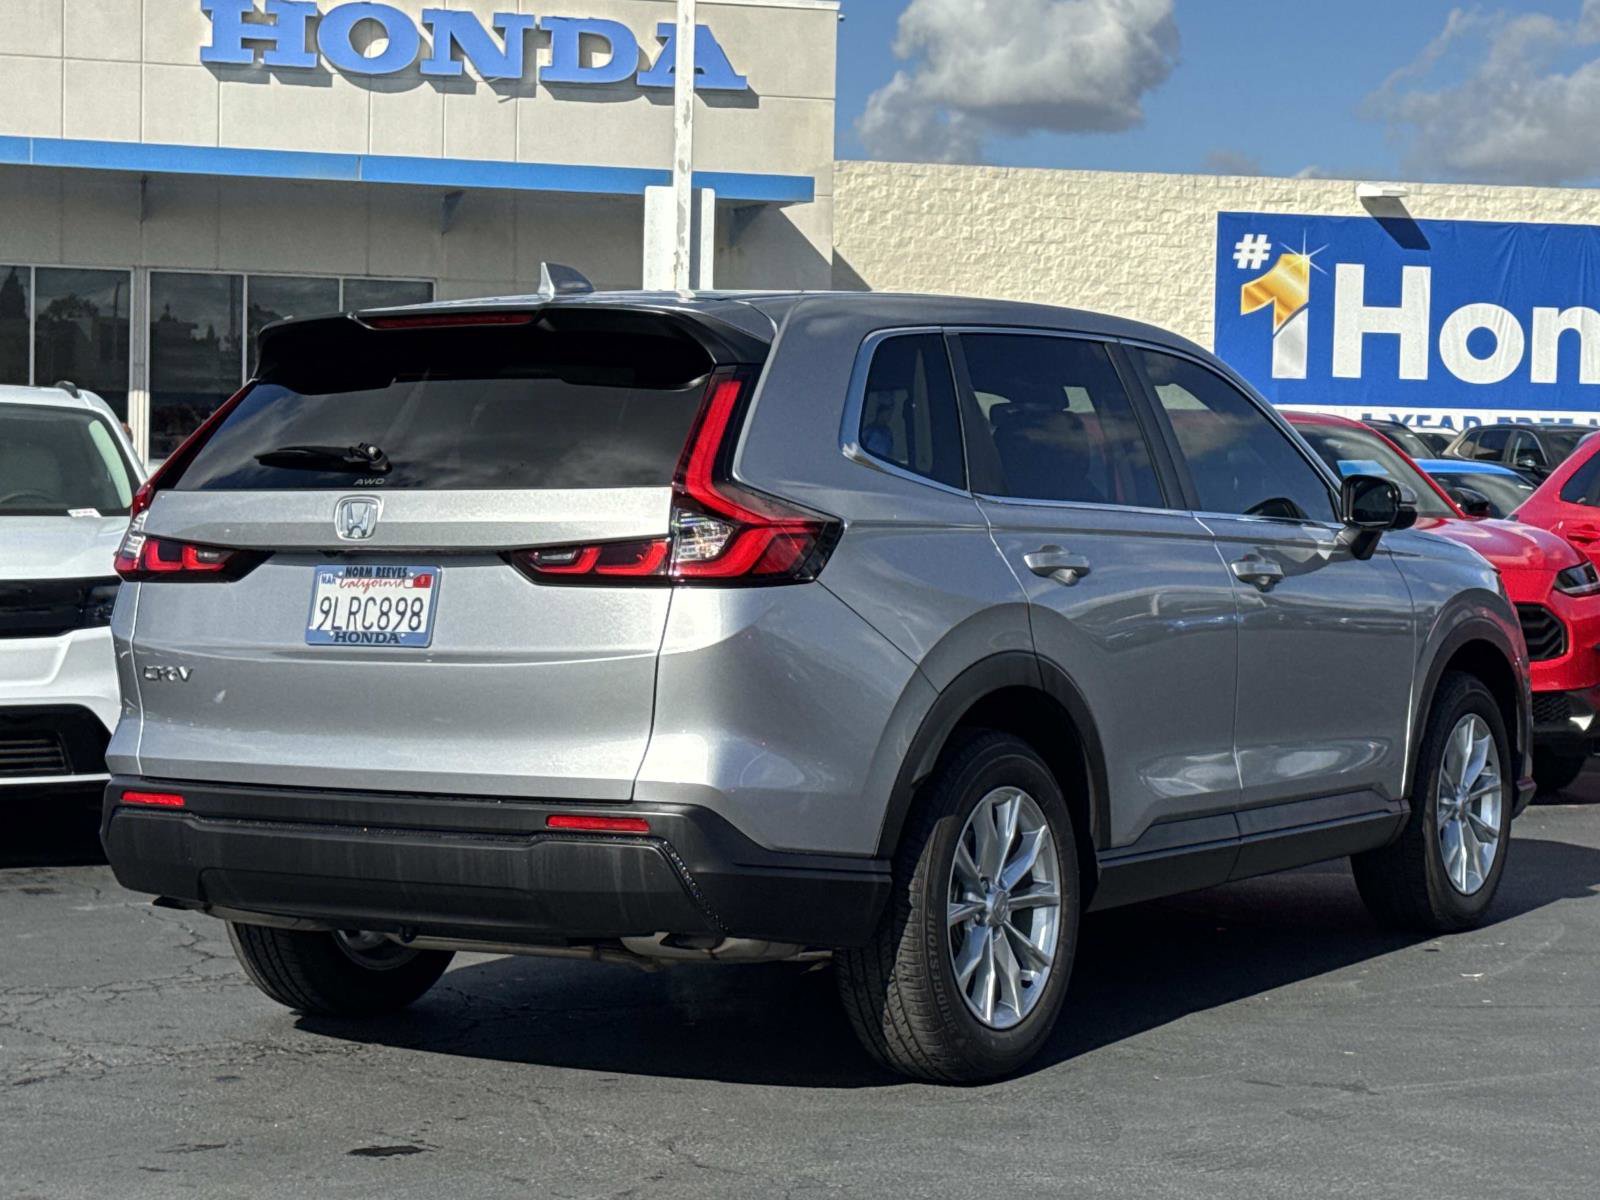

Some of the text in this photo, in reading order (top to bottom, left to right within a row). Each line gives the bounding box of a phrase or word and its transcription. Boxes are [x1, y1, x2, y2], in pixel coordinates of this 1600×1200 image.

[200, 0, 748, 90] HONDA
[353, 478, 385, 487] AWD
[345, 567, 407, 579] NORM REEVES
[339, 576, 410, 595] California
[317, 596, 424, 631] 9LRC898
[334, 631, 400, 643] HONDA
